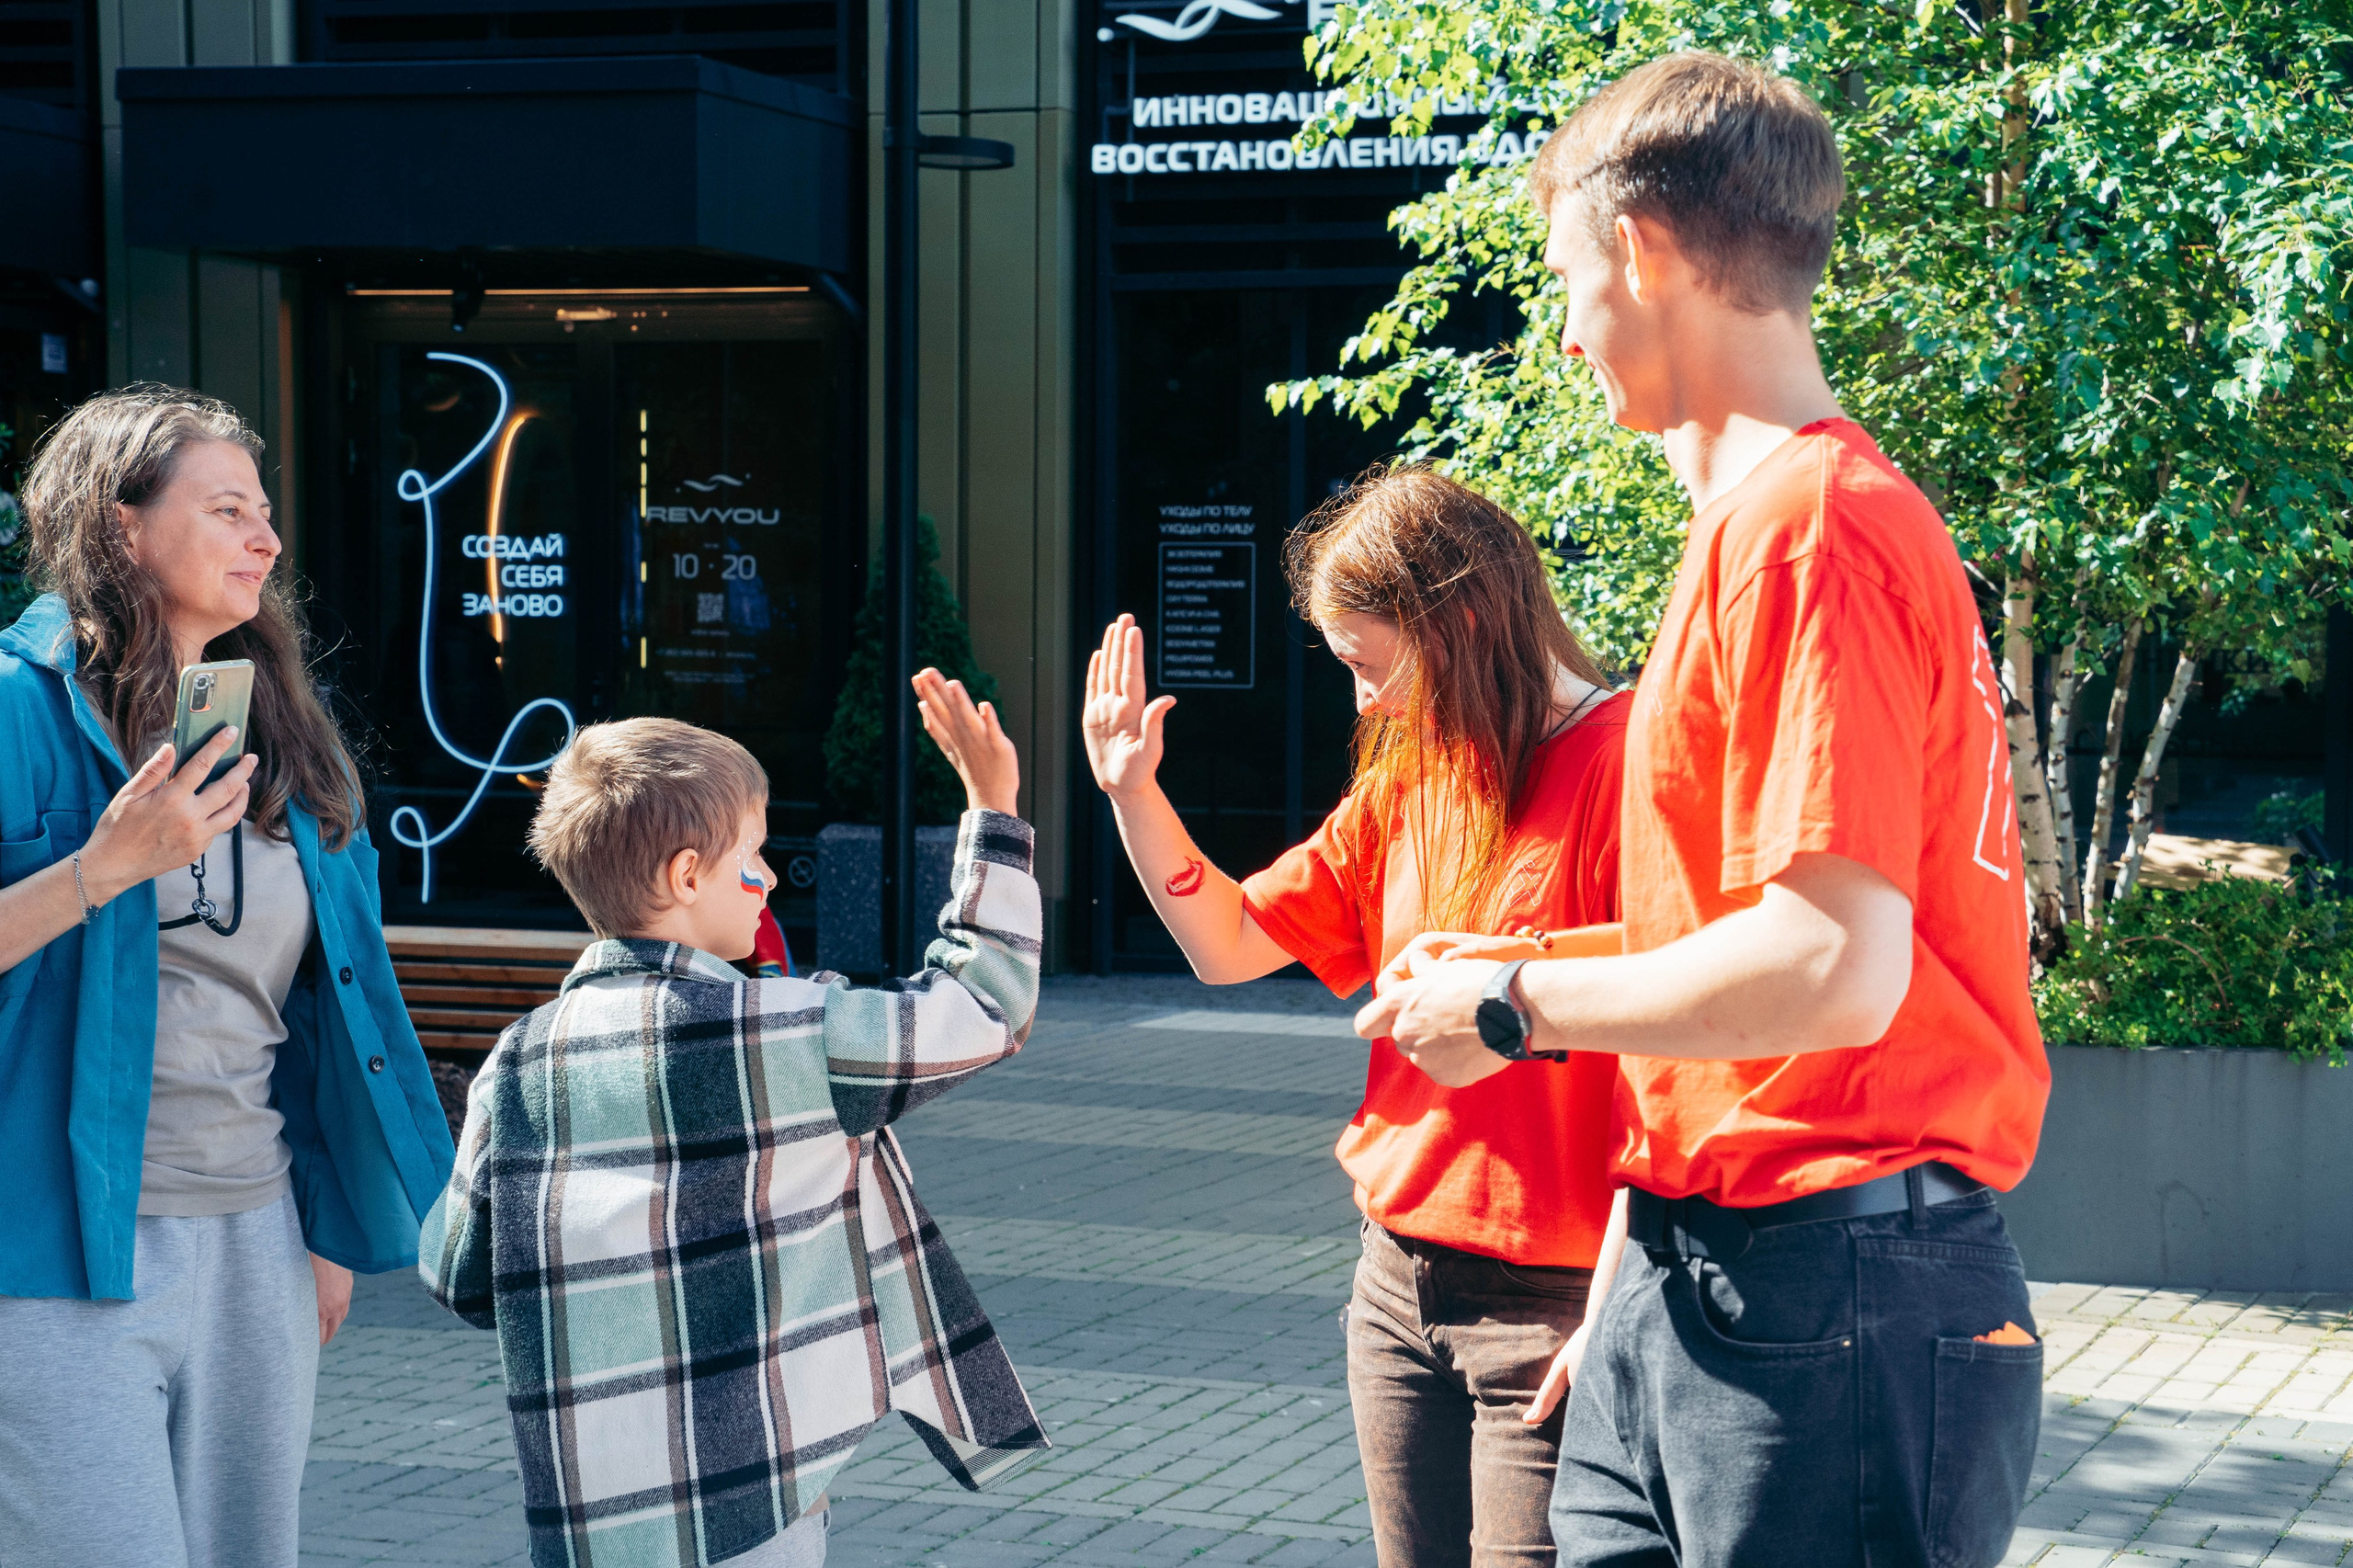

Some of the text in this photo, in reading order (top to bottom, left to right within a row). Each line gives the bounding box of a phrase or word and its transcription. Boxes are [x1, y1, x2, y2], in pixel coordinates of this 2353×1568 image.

[1091, 133, 1461, 175] ВОССТАНОВЛЕНИЯ
[645, 506, 780, 525] REVYOU
[1203, 506, 1222, 517] ПО
[1203, 523, 1222, 535] ПО
[461, 532, 563, 562] СОЗДАЙ
[500, 564, 563, 588] СЕБЯ
[673, 552, 756, 580] 10 20
[461, 592, 563, 618] ЗАНОВО
